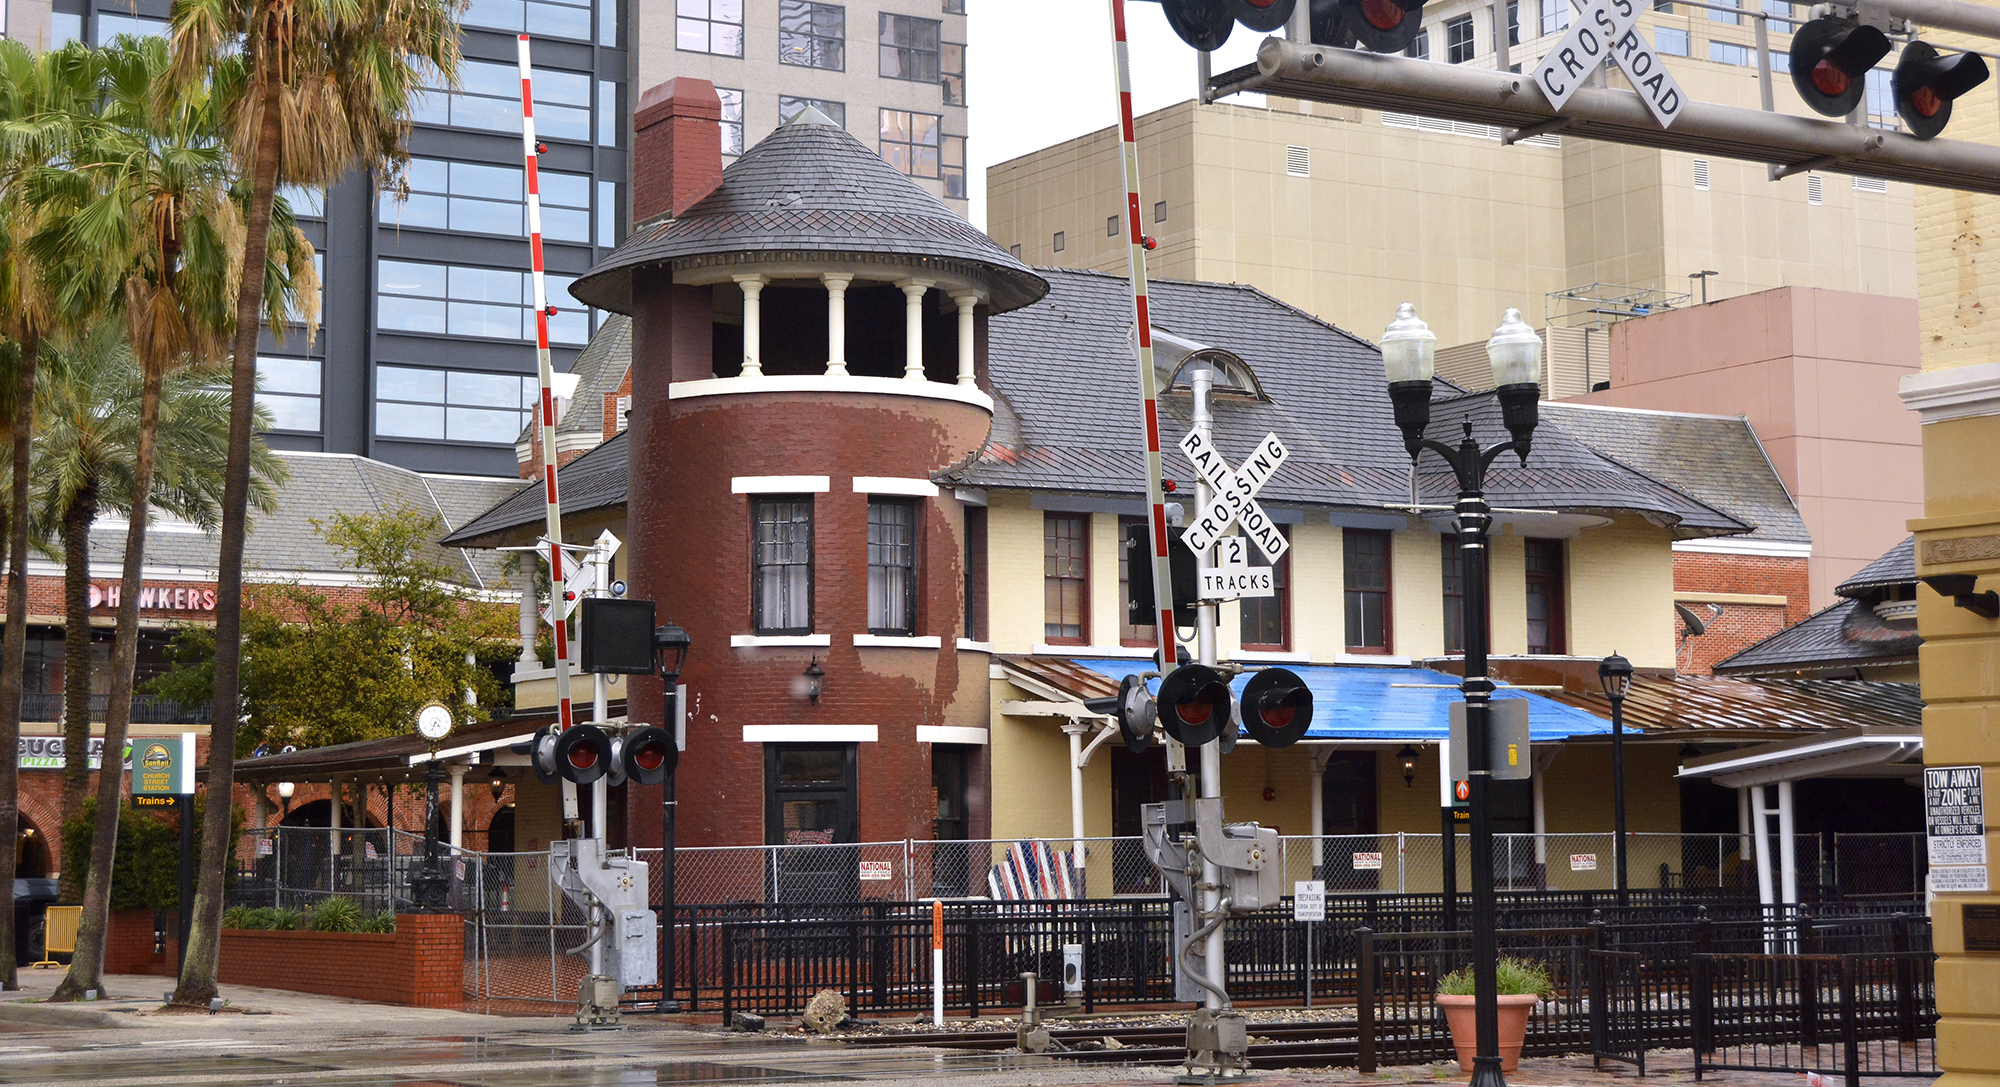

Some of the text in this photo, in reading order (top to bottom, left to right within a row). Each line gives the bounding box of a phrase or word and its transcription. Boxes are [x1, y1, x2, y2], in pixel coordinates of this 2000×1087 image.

[1543, 0, 1645, 97] CROSS
[1616, 29, 1679, 116] ROAD
[1184, 433, 1282, 555] RAIL ROAD
[1189, 441, 1282, 551] CROSSING
[1229, 542, 1241, 563] 2
[1204, 574, 1270, 590] TRACKS
[107, 585, 216, 611] HWKERS
[22, 757, 59, 767] PIZZA
[1927, 769, 1979, 788] TOW AWAY
[137, 796, 166, 805] Trains
[1941, 788, 1968, 806] ZONE
[1453, 811, 1470, 819] Train
[1960, 825, 1977, 834] EXPENSE
[1933, 839, 1981, 849] STRICTLY ENFORCED
[1354, 853, 1380, 861] NATIONAL
[861, 862, 890, 871] NATIONAL
